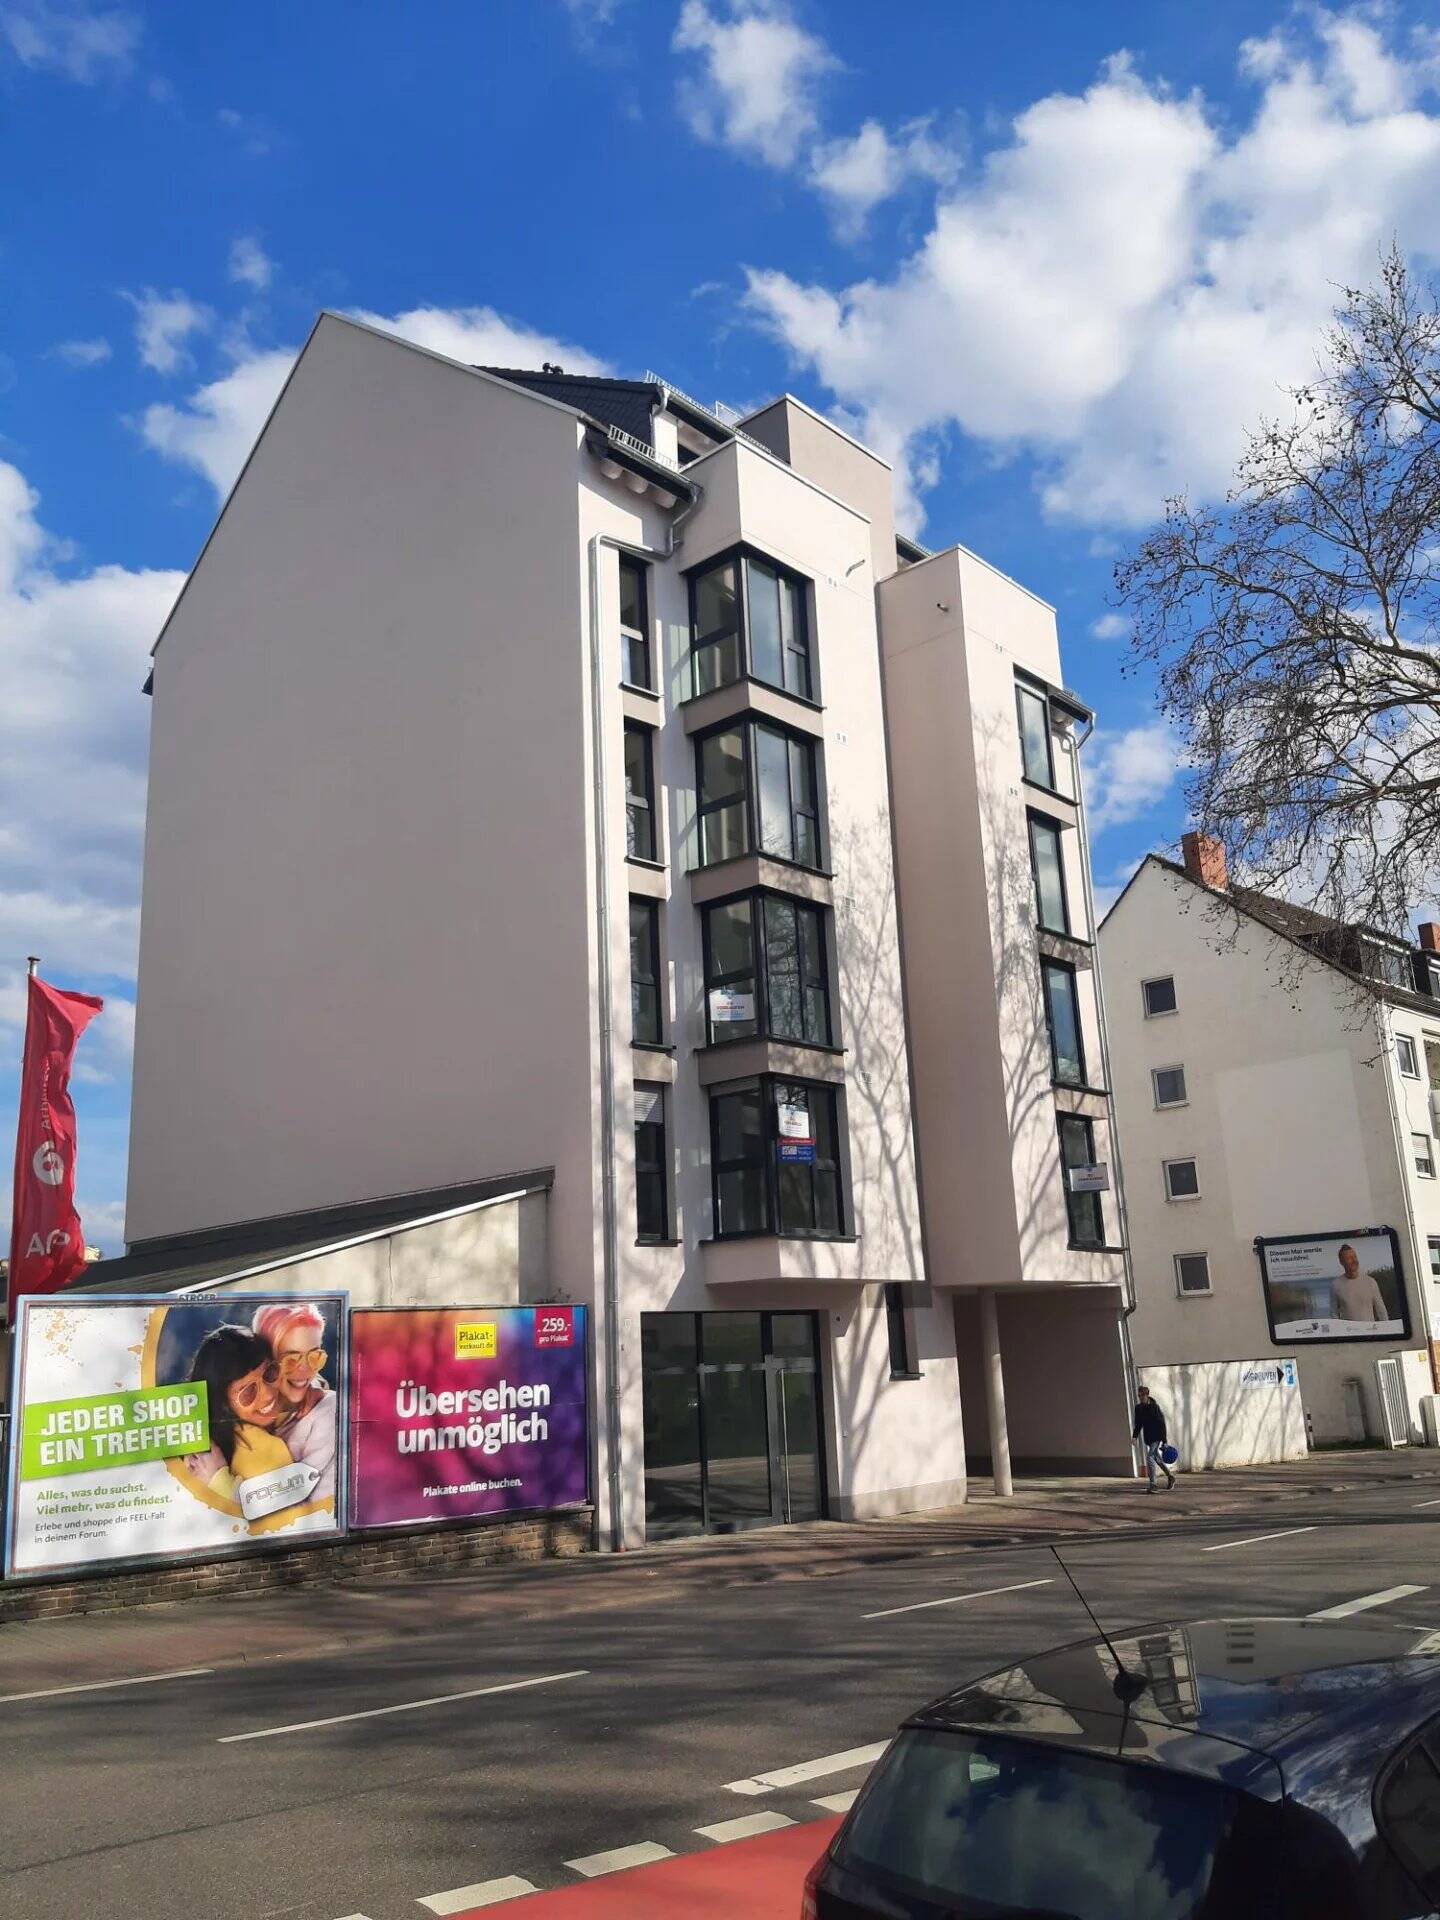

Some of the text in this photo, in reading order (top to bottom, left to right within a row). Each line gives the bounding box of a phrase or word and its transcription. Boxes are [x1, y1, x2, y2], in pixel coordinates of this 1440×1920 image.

[396, 1380, 550, 1418] Übersehen
[40, 1394, 198, 1436] JEDER SHOP
[40, 1420, 203, 1465] EIN TREFFER!
[398, 1412, 548, 1455] unmöglich
[37, 1483, 147, 1500] Alles, was du suchst.
[423, 1478, 523, 1497] Plakate online buchen.
[37, 1495, 173, 1516] Viel mehr, was du findest.
[35, 1523, 63, 1532] Erlebe
[64, 1520, 80, 1529] und
[83, 1518, 113, 1528] shoppe
[115, 1515, 128, 1524] die
[35, 1530, 108, 1543] in deinem Forum.
